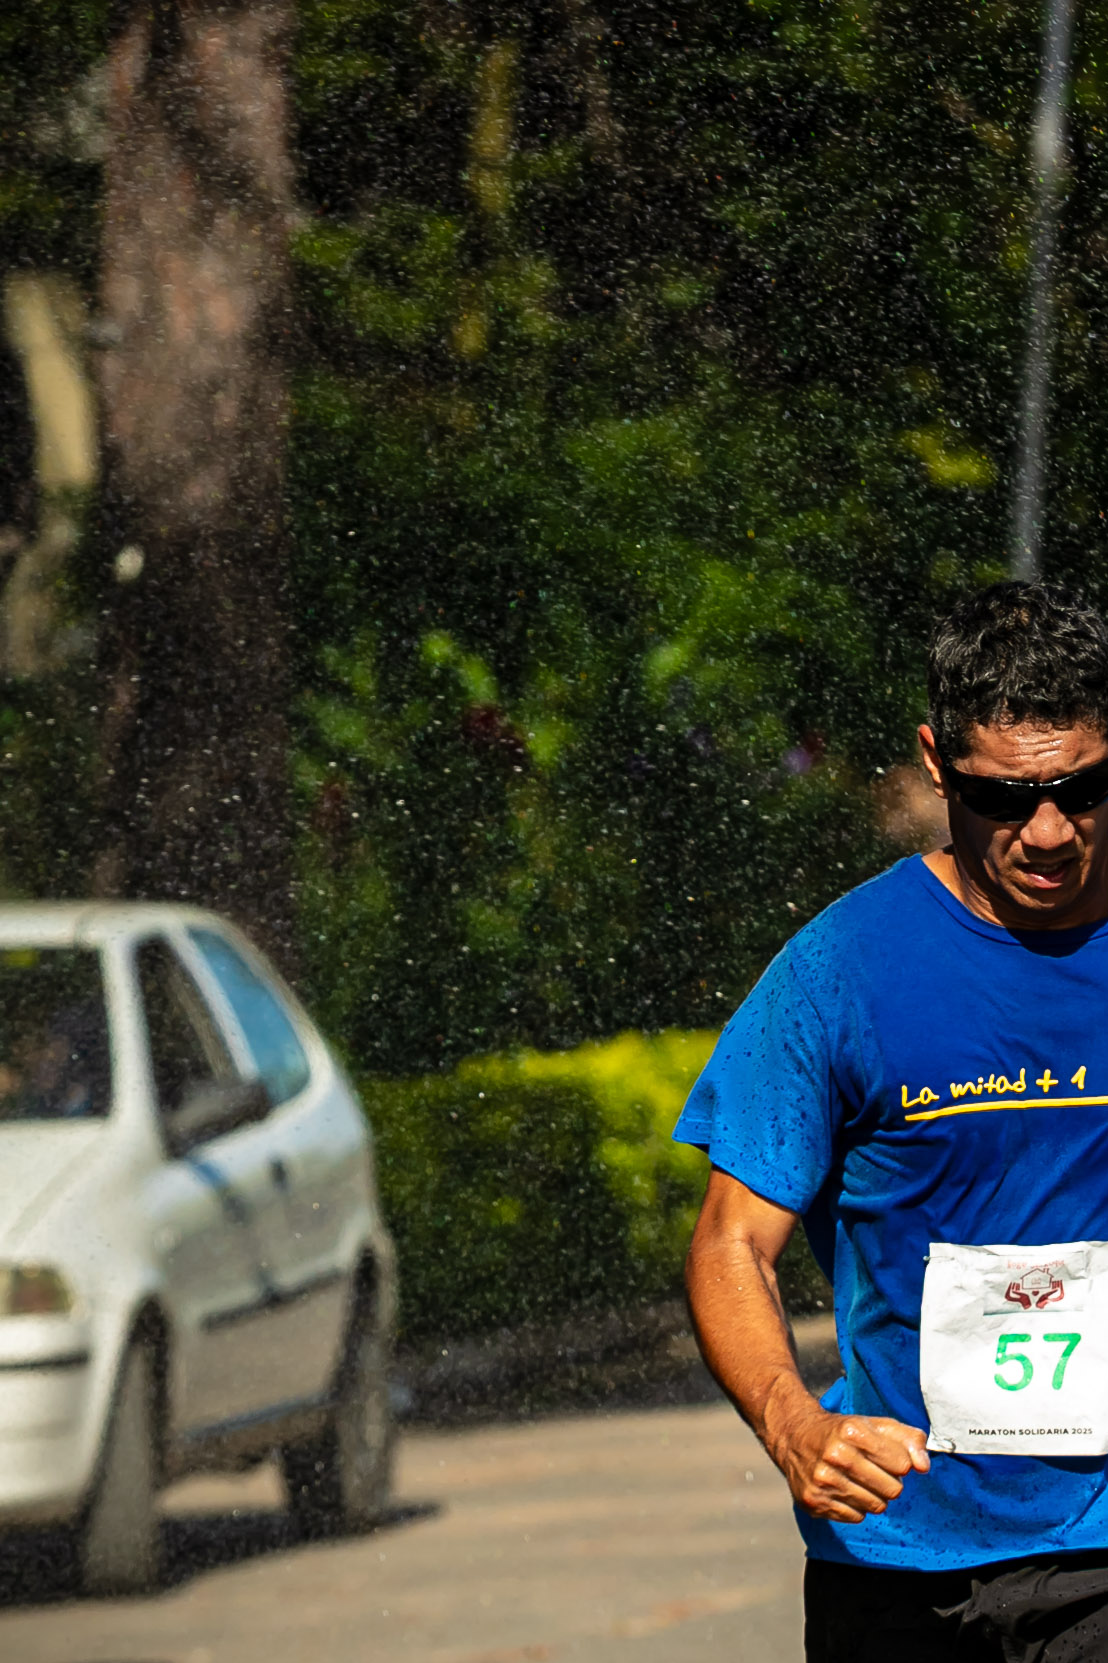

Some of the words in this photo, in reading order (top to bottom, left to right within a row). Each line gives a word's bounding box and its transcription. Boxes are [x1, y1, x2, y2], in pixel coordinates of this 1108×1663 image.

[901, 1085, 940, 1108] La
[950, 1067, 1027, 1098] mitad
[1070, 1065, 1087, 1090] 1
[994, 1333, 1082, 1391] 57
